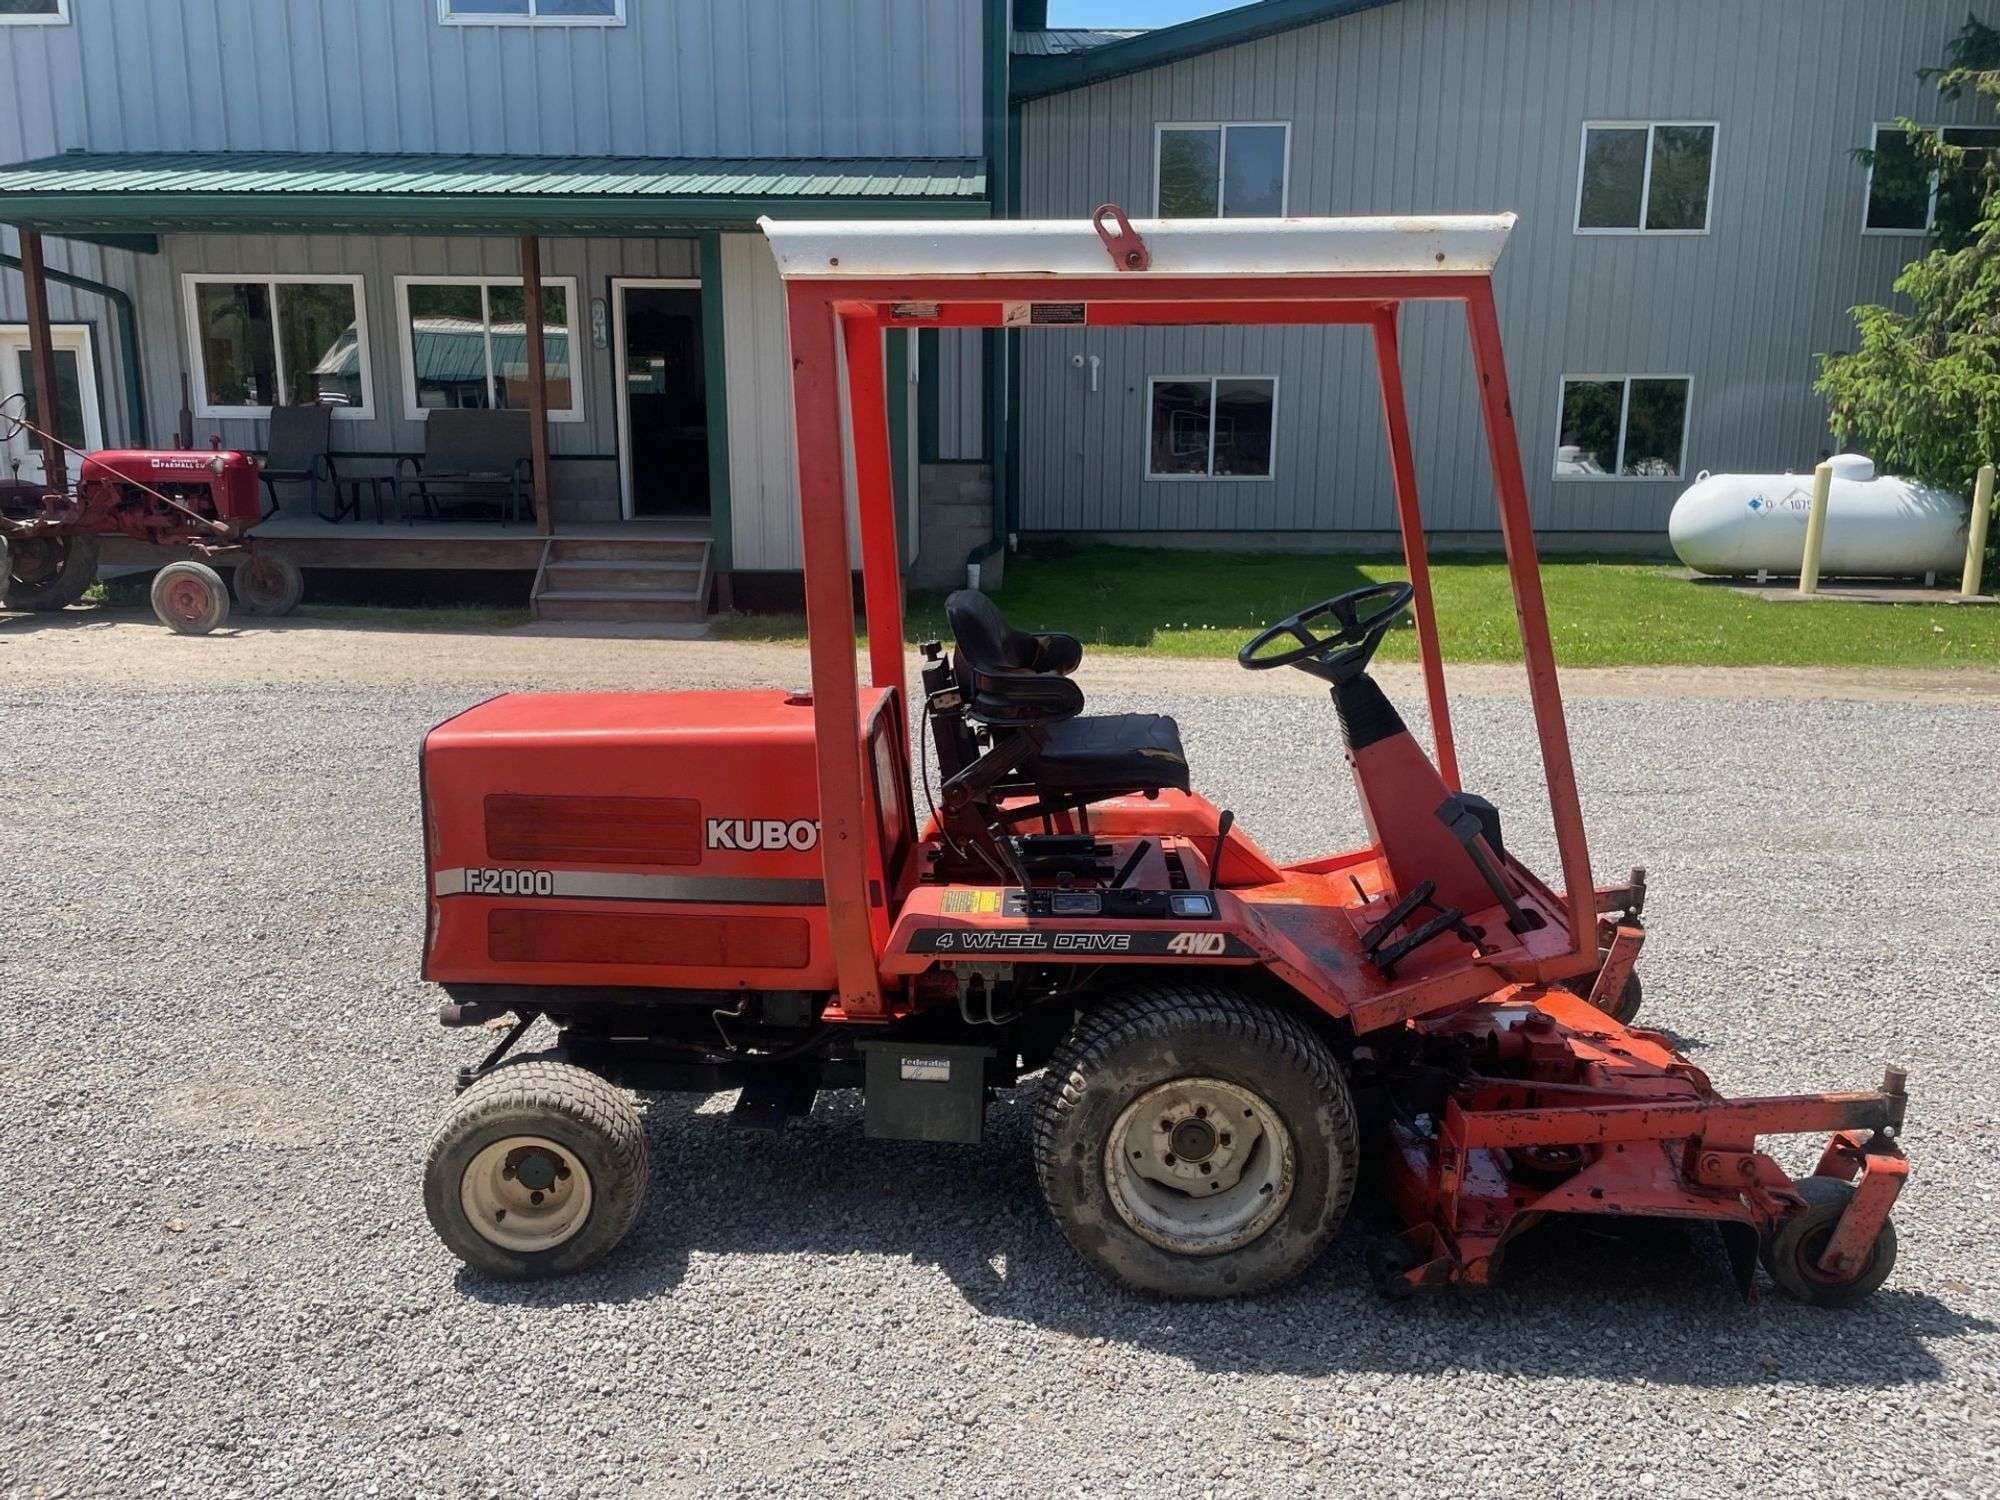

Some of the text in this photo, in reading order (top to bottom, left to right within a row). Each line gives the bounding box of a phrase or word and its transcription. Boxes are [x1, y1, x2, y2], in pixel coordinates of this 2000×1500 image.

[464, 868, 553, 896] F2000
[936, 932, 1131, 950] 4 WHEEL DRIVE
[1166, 932, 1226, 955] 4WD
